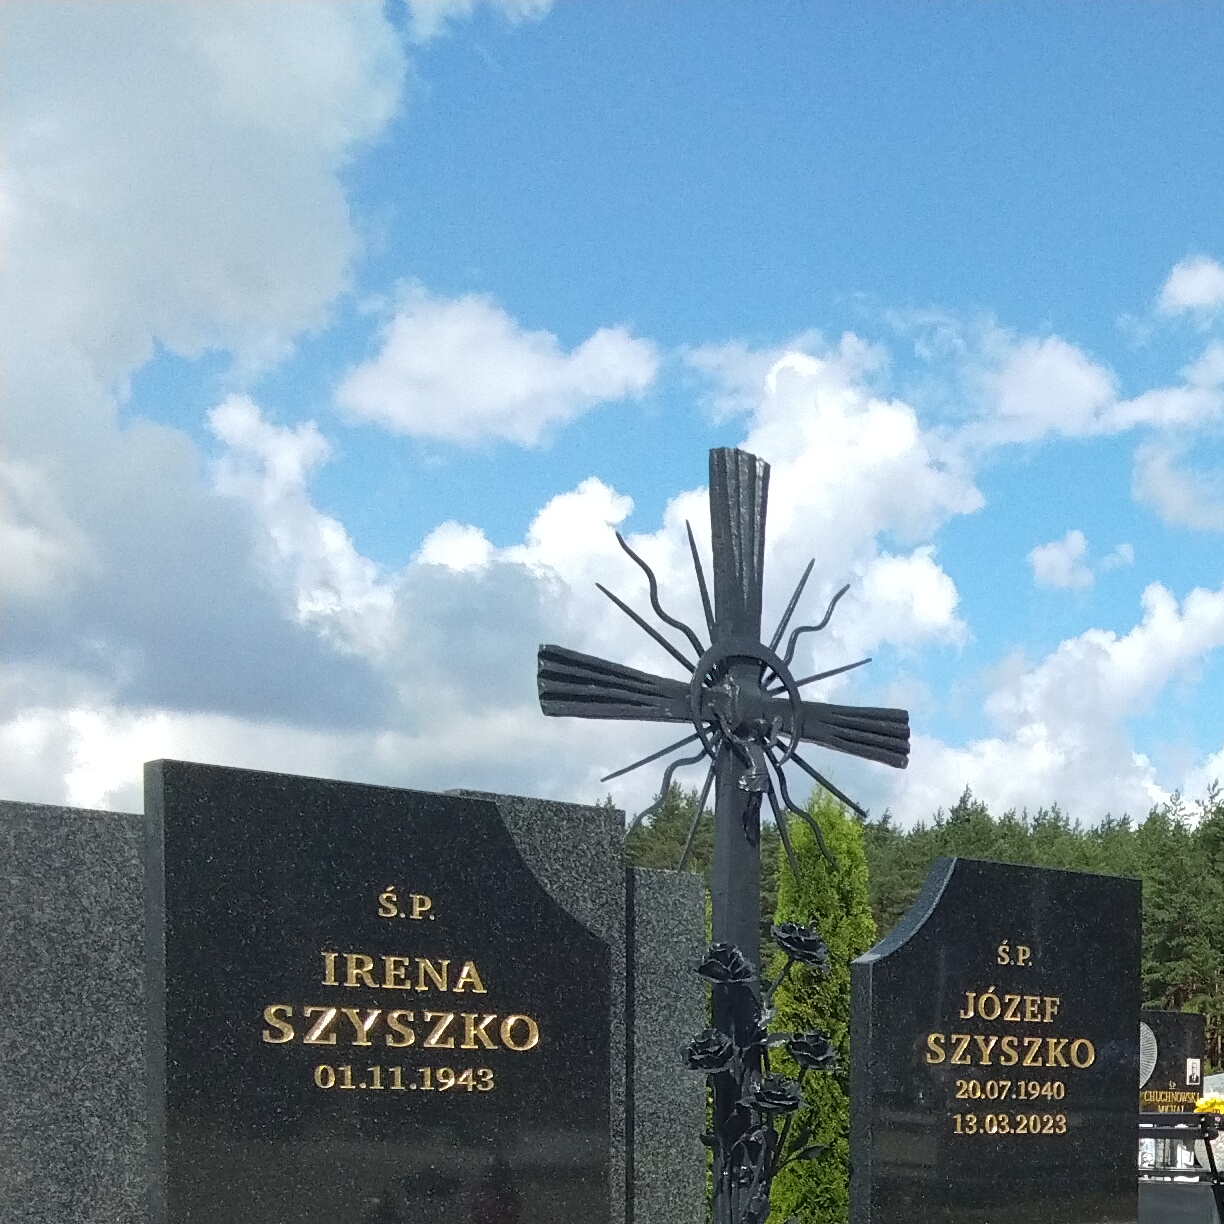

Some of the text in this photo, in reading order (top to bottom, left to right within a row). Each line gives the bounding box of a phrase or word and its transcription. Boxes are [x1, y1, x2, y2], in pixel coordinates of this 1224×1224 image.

[378, 886, 435, 921] Ś.P.
[997, 939, 1033, 966] Ś.P.
[321, 951, 488, 994] IRENA
[959, 985, 1060, 1023] JÓZEF
[262, 1003, 540, 1050] SZYSZKO
[926, 1033, 1096, 1069] SZYSZKO
[313, 1064, 495, 1092] 01.11.1943
[955, 1079, 1065, 1100] 20.07.1940
[953, 1113, 1067, 1134] 13.03.2023
